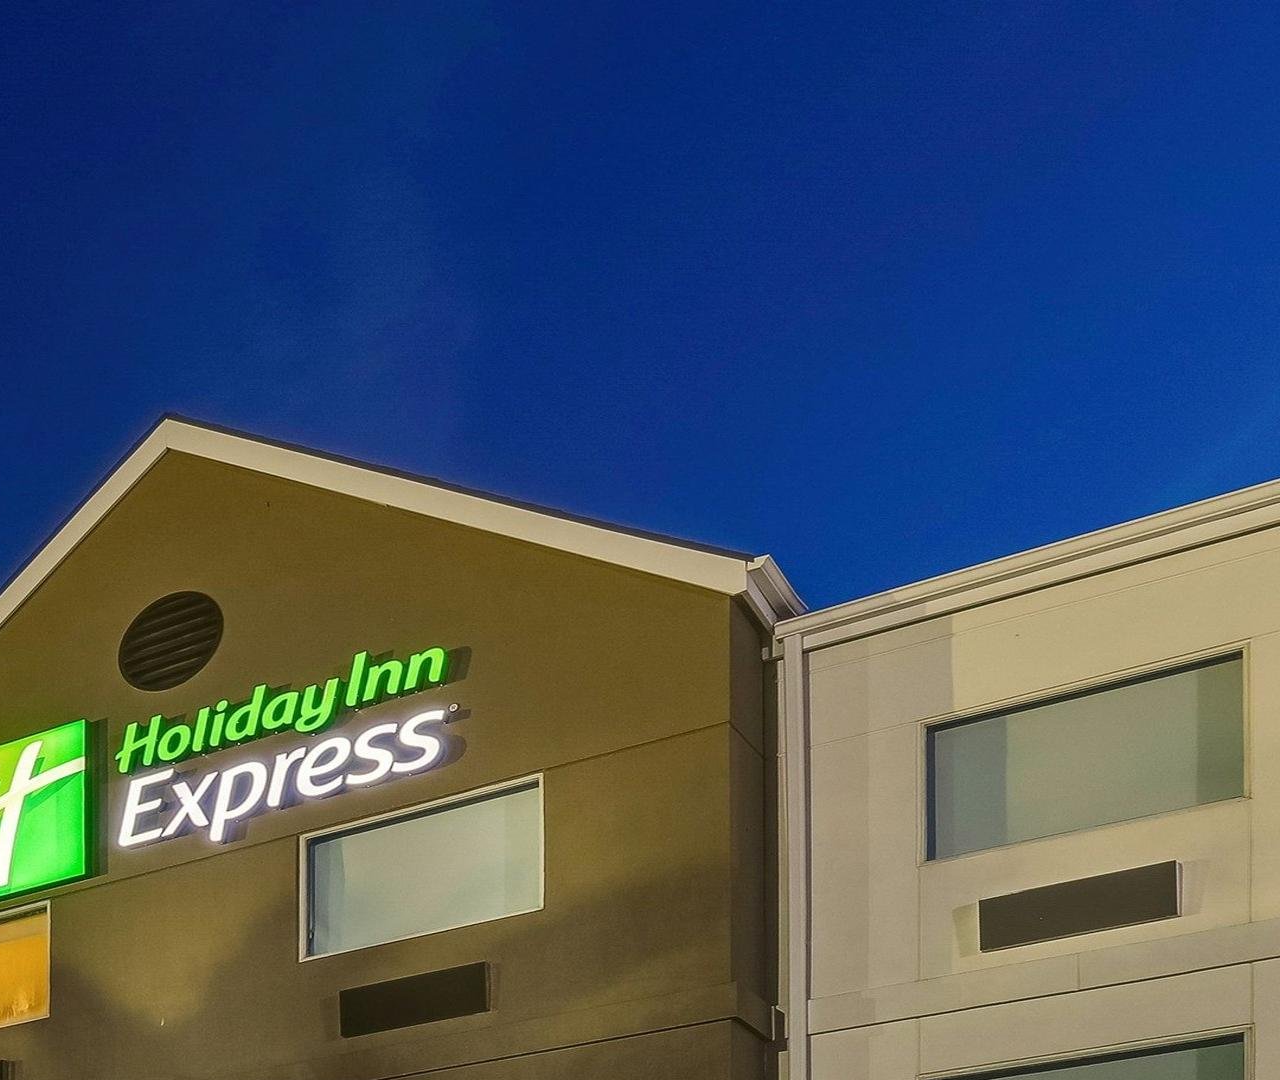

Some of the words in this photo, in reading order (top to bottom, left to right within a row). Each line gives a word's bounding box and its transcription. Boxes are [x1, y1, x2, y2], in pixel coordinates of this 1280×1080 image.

[114, 677, 341, 774] Holiday
[345, 647, 445, 707] Inn
[118, 709, 445, 847] Express
